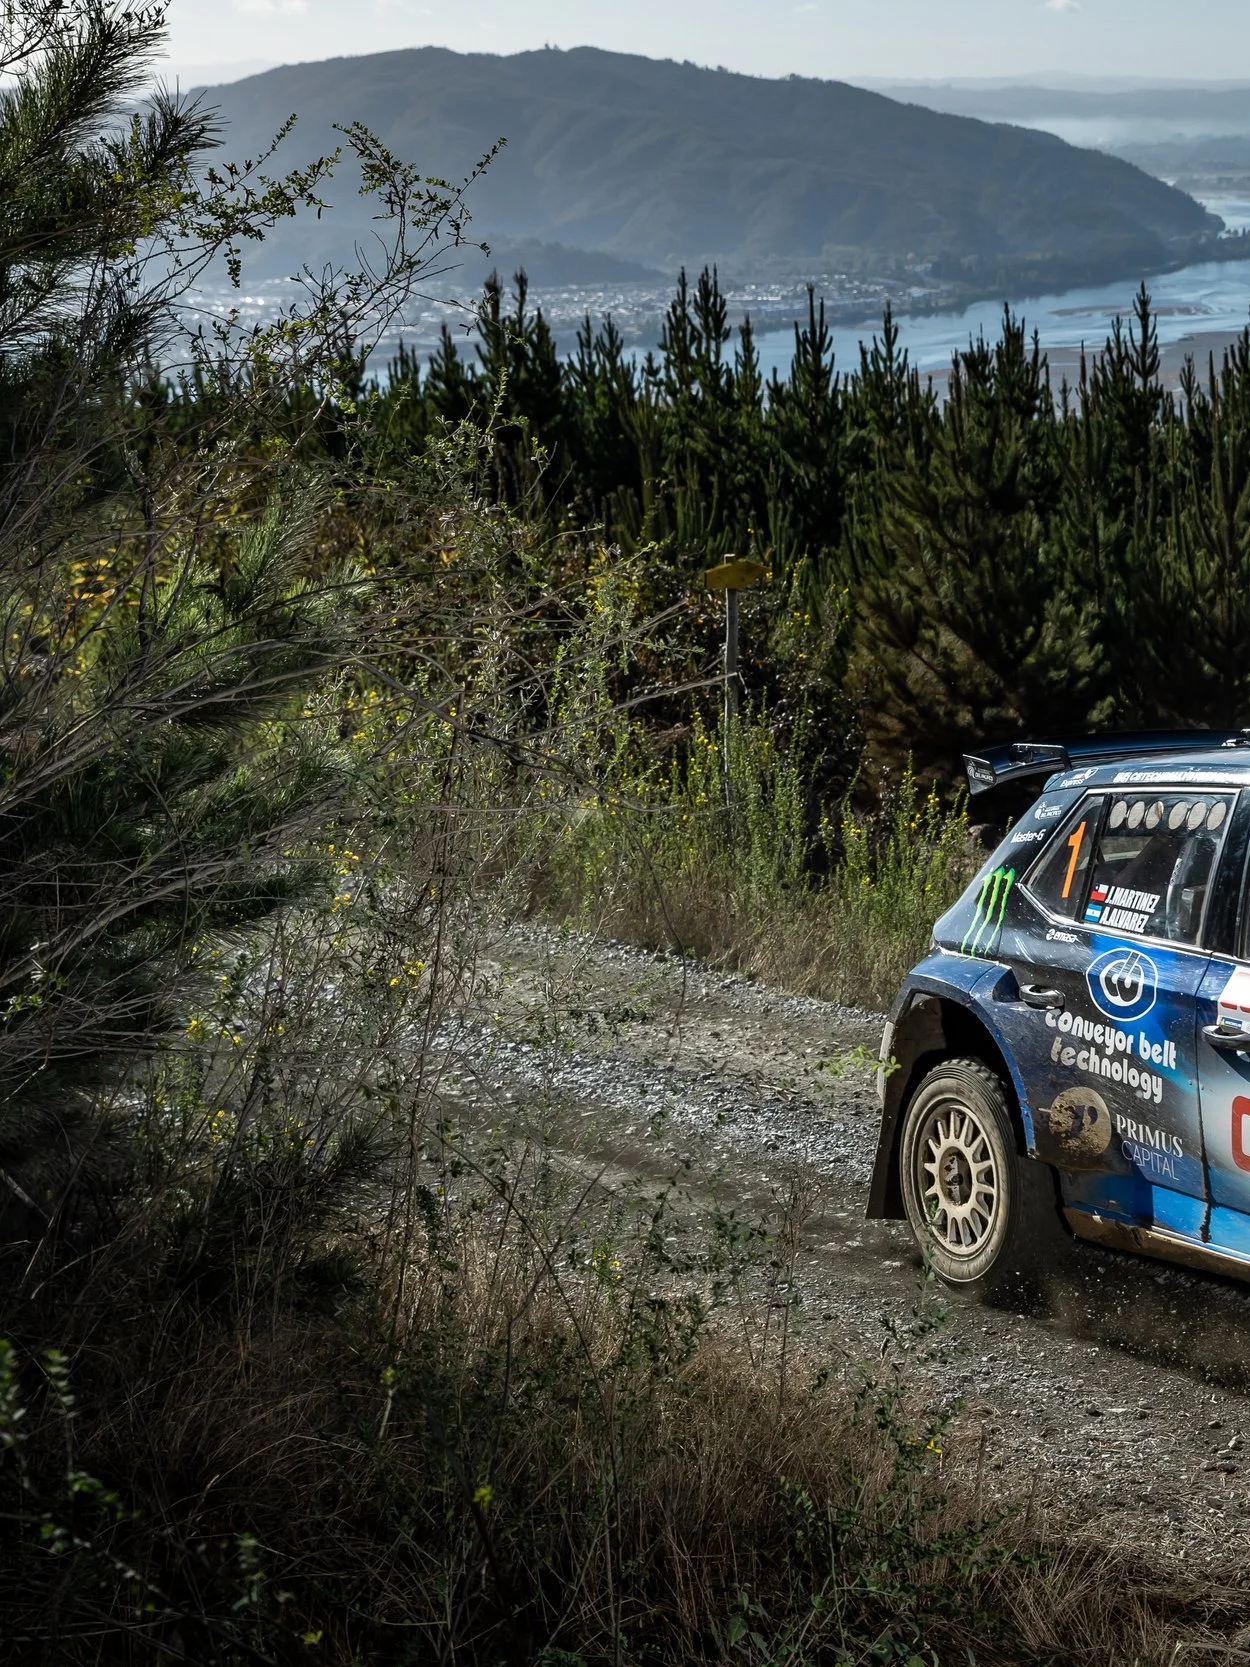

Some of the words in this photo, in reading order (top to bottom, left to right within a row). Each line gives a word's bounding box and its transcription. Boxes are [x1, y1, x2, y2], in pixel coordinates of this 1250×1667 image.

[1010, 828, 1047, 844] Master-G
[1061, 821, 1087, 898] 1
[1098, 906, 1150, 934] A.ALVAREZ
[1104, 885, 1161, 914] J.MARTINEZ
[1045, 1009, 1134, 1056] conveyor
[1139, 1031, 1177, 1070] belt
[1050, 1036, 1164, 1104] technology
[1116, 1113, 1184, 1158] PRIMUS
[1121, 1140, 1180, 1181] CAPITAL
